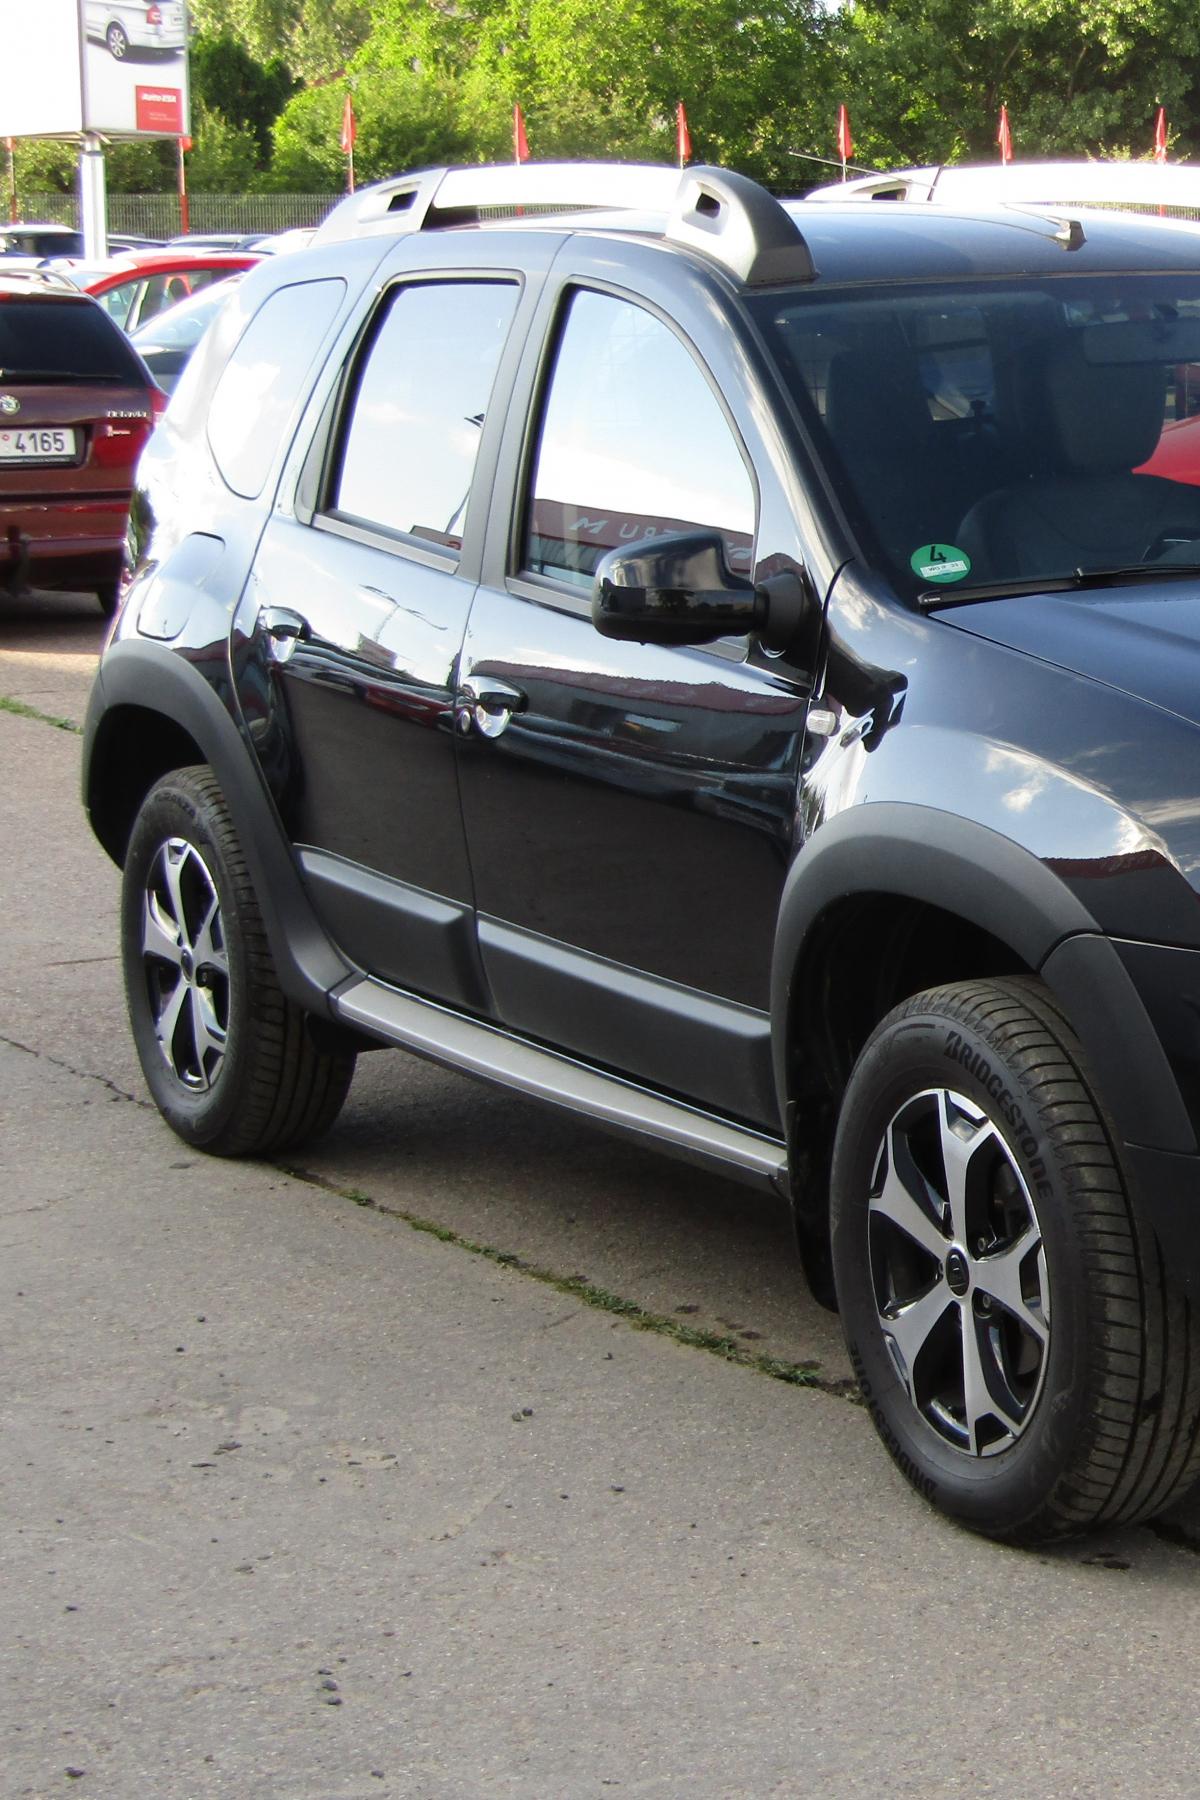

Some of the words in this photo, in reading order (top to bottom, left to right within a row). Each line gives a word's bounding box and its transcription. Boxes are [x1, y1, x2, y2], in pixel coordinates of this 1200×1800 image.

[15, 432, 65, 453] 4165
[930, 544, 947, 563] 4
[943, 1030, 1054, 1199] BRIDGESTONE
